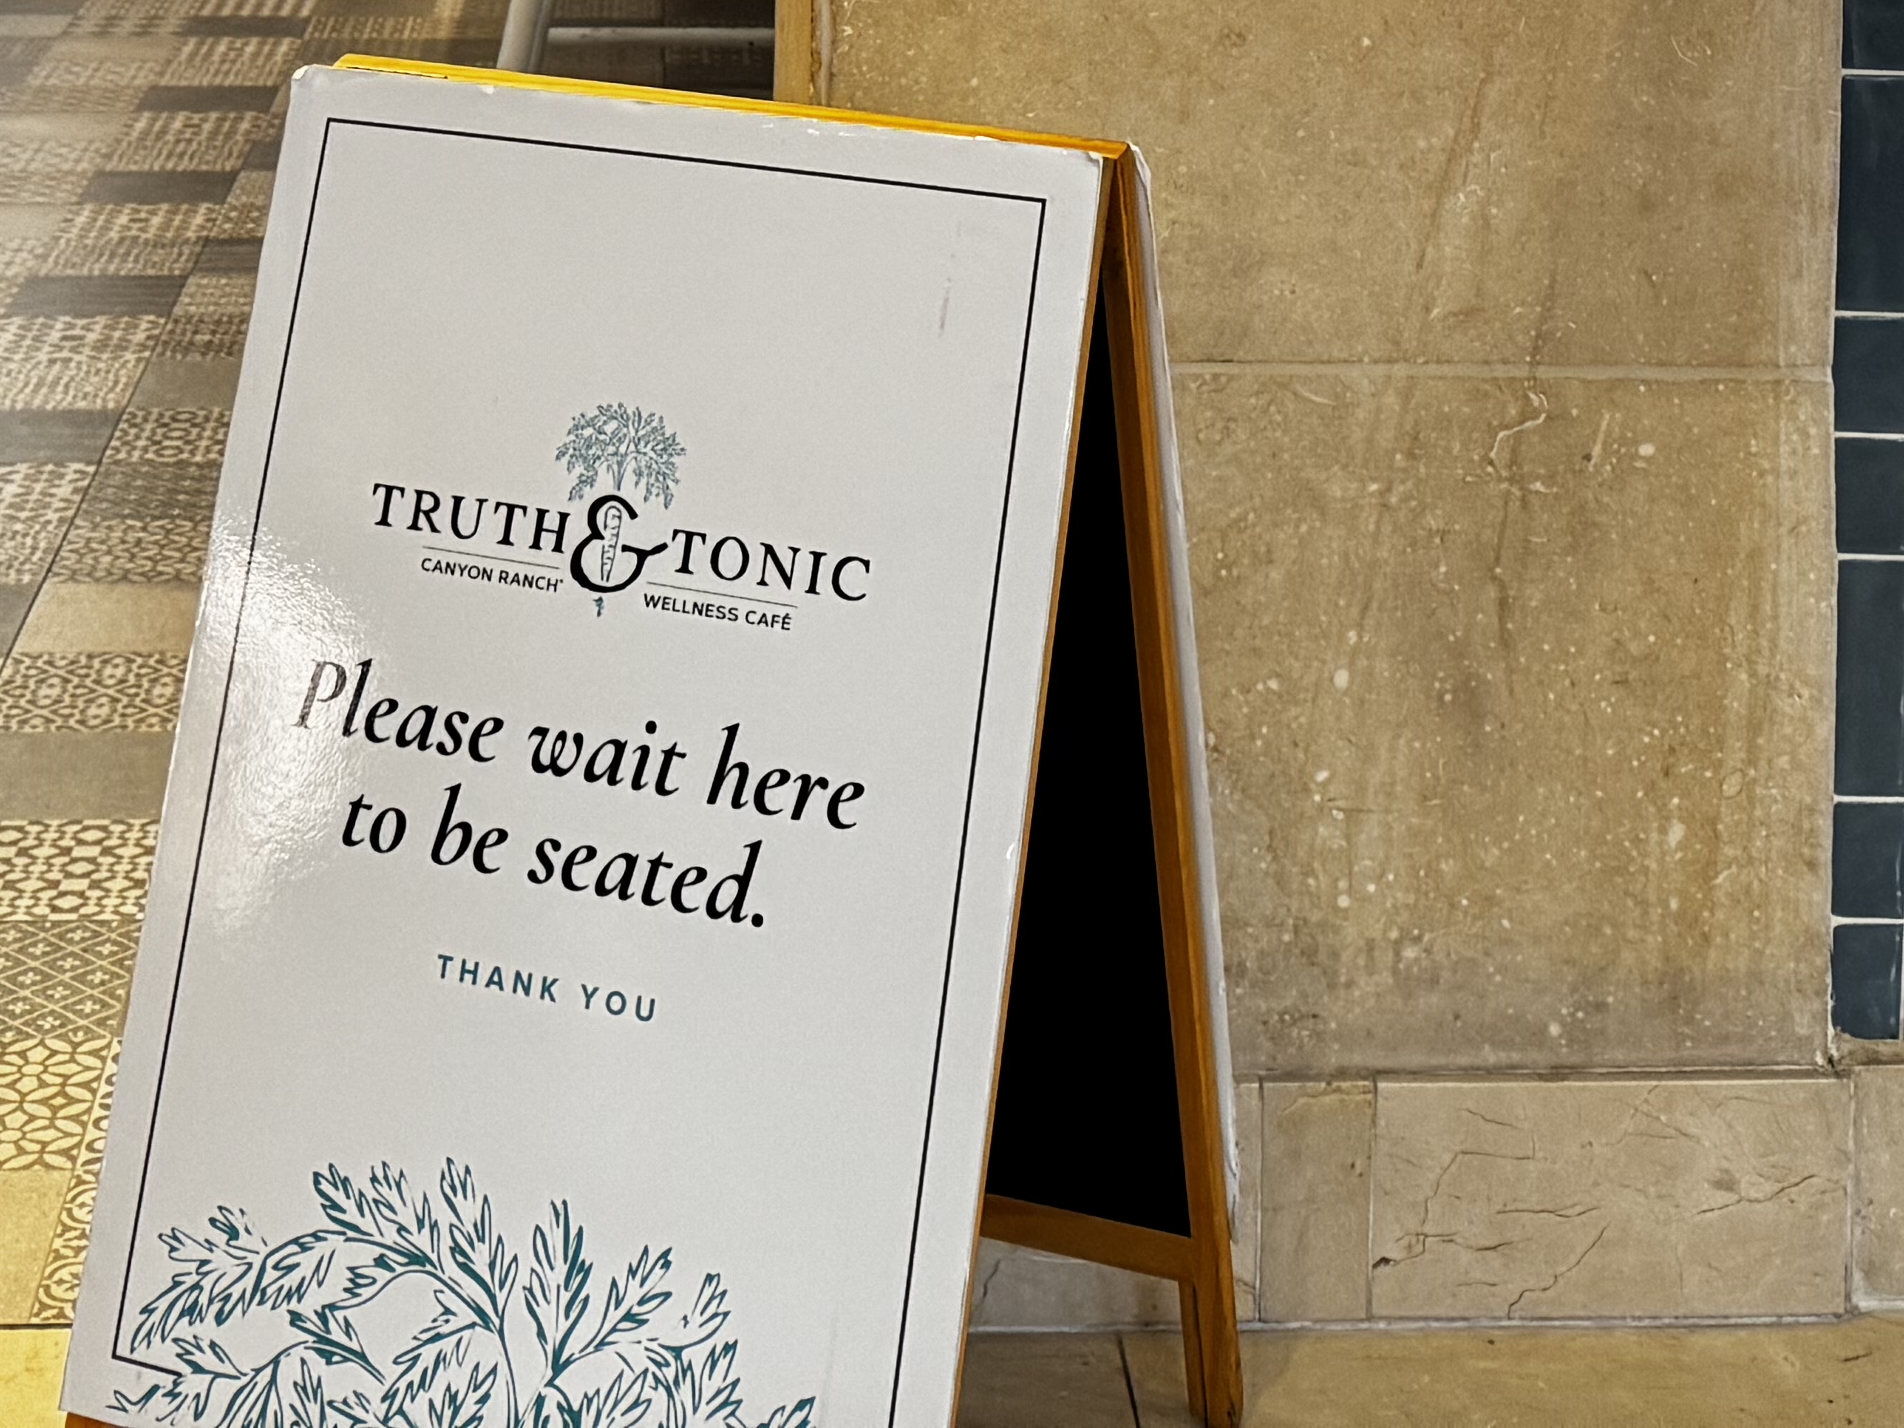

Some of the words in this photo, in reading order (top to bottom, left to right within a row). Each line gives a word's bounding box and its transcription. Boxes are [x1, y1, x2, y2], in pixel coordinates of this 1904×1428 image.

[372, 483, 570, 553] TRUTH
[570, 494, 669, 593] &
[671, 529, 871, 601] TONIC
[421, 558, 493, 583] CANYON
[498, 569, 558, 593] RANCH
[644, 594, 739, 622] WELLNESS
[745, 610, 793, 632] CAFÉ
[294, 658, 504, 762] Please
[527, 720, 687, 795] wait
[707, 722, 865, 829] here
[341, 790, 407, 853] to
[430, 783, 508, 874] be
[527, 840, 766, 928] seated.
[437, 954, 558, 1003] THANK
[581, 984, 657, 1022] YOU
